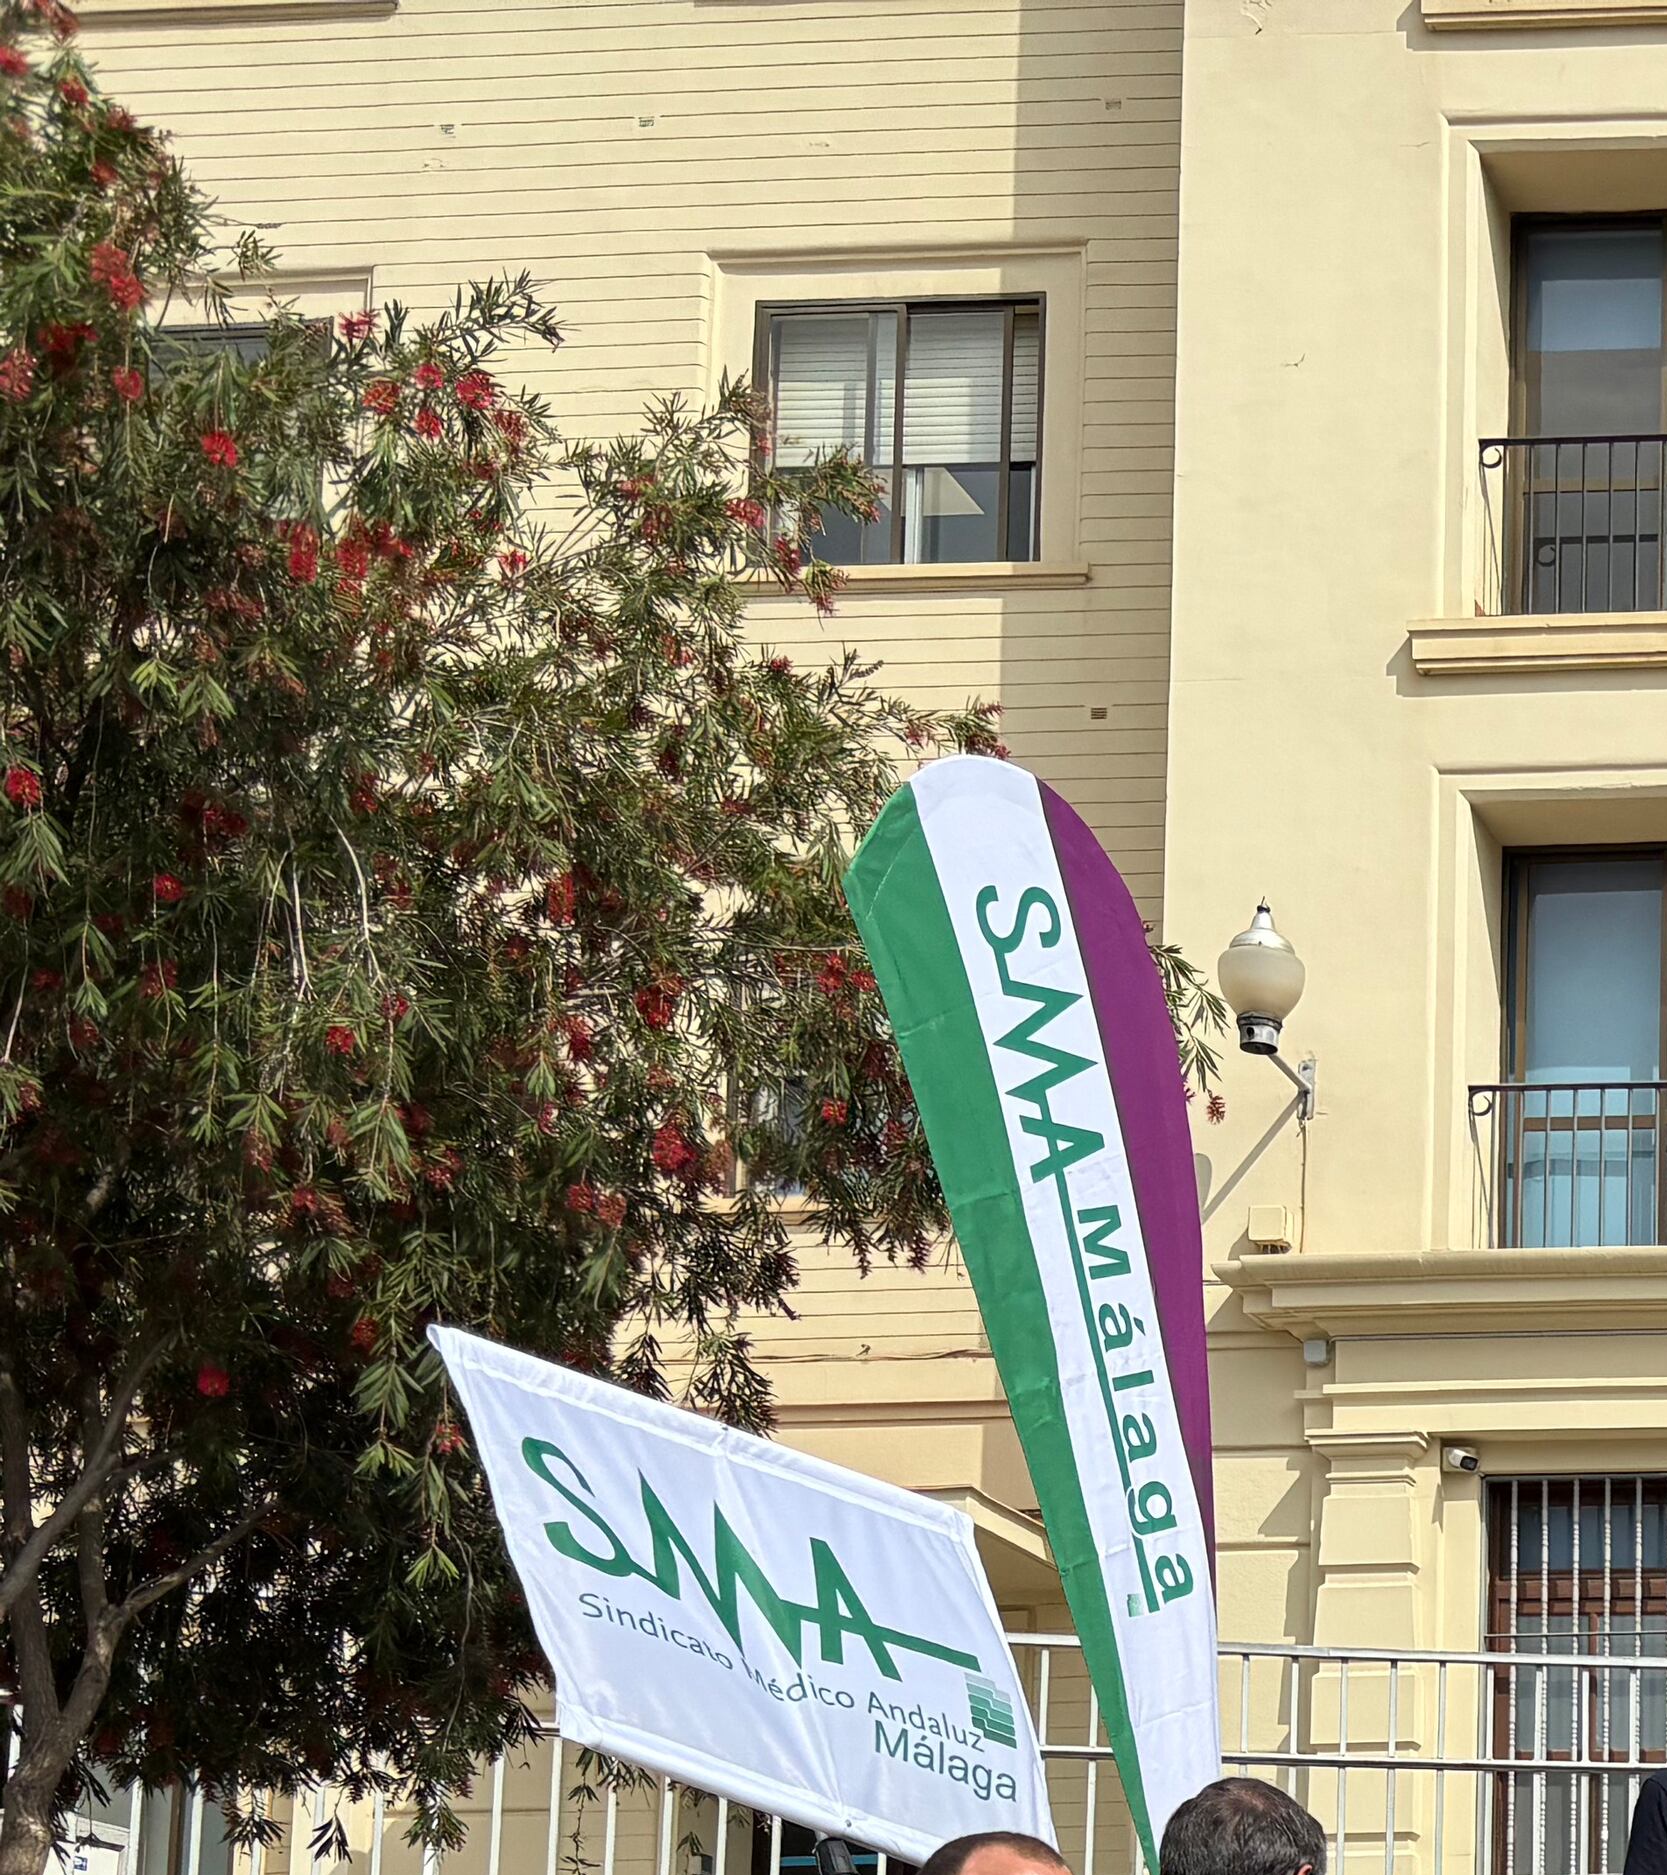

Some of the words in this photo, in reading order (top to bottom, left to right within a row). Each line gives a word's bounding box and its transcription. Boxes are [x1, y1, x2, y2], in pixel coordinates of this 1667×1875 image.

[976, 886, 1105, 1183] SMA
[1078, 1204, 1195, 1604] Málaga
[521, 1437, 901, 1683] SMA
[578, 1593, 733, 1670] Sindicato
[742, 1656, 855, 1709] Médico
[868, 1691, 985, 1753] Andaluz
[875, 1720, 1017, 1802] Málaga
